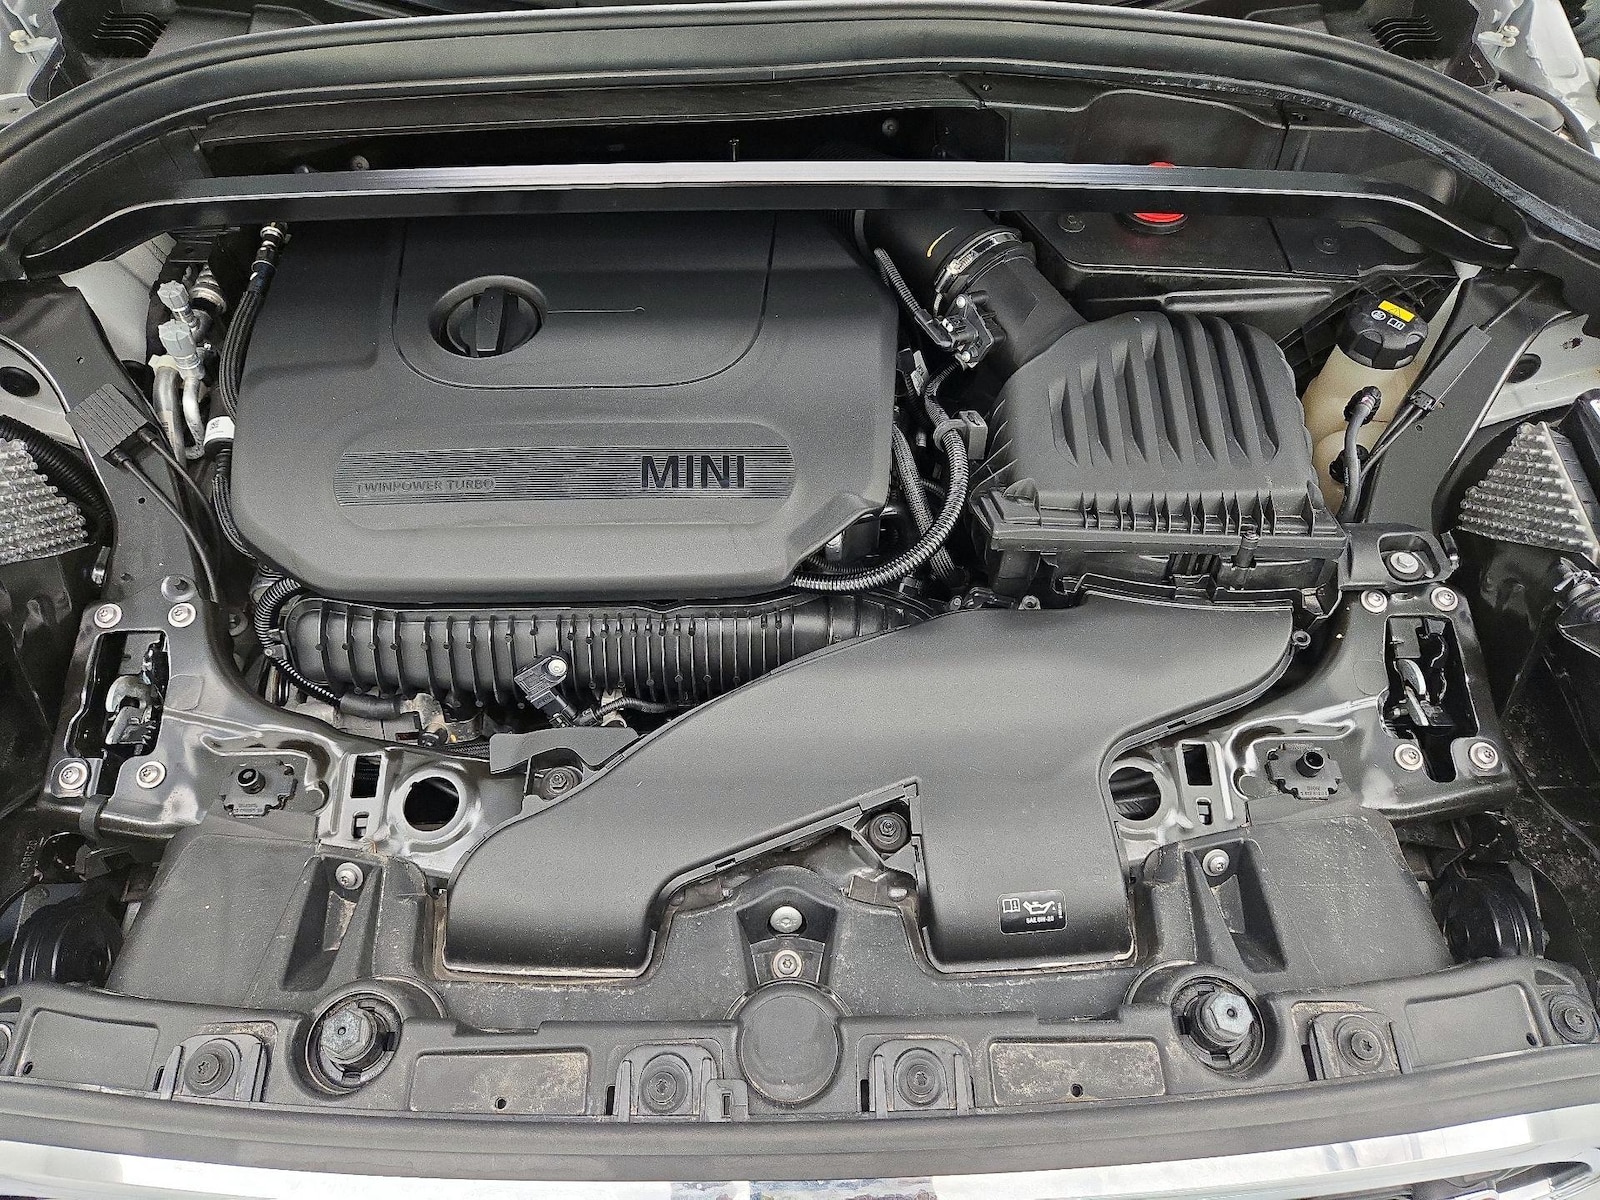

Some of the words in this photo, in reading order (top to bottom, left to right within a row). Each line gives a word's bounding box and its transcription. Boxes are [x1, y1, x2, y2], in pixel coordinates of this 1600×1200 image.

[641, 455, 745, 489] MINI
[355, 480, 443, 494] TWINPOWER
[447, 478, 495, 491] TURBO
